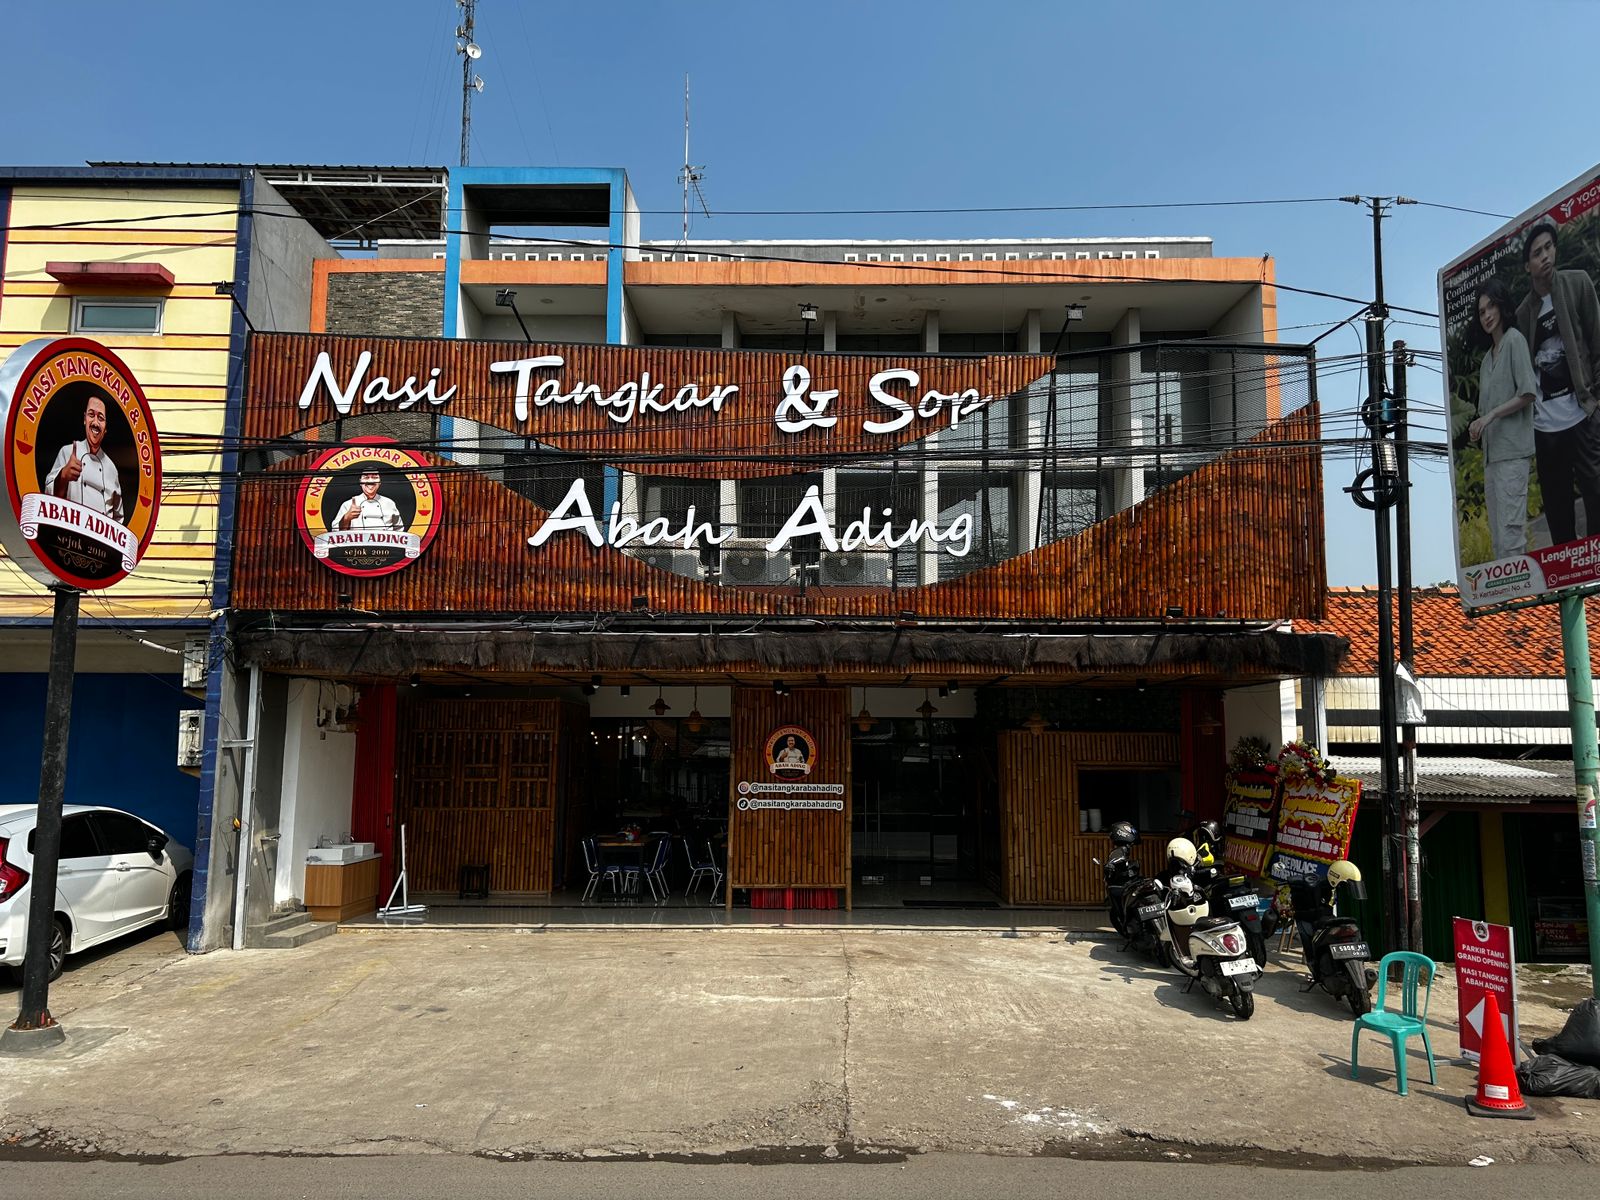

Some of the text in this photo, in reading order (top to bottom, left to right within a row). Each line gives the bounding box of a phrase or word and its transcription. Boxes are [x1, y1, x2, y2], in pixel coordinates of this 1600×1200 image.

[1481, 258, 1488, 269] is
[1446, 263, 1496, 301] Comfort and
[1447, 290, 1476, 313] Feeling
[299, 350, 992, 434] Nasi Tangkar & Sop
[22, 355, 152, 478] NASI TANGKAR & SOP
[333, 447, 401, 467] TANGKAR
[37, 500, 127, 548] ABAH ADING
[527, 478, 973, 557] Abah Ading
[327, 533, 409, 545] ABAH ADING
[87, 545, 107, 559] 2010
[1541, 541, 1588, 564] Lengkapi
[1485, 559, 1530, 580] YOGYA
[750, 783, 843, 794] @nasitangkarabahading
[749, 800, 842, 810] @nasitangkarabahading
[1290, 857, 1318, 873] PALACE
[1462, 943, 1505, 959] PARKIR TAMU
[1457, 952, 1510, 970] GRAND OPENING
[1461, 966, 1509, 984] NASI TANGKAR
[1465, 977, 1506, 993] ABAH ADING
